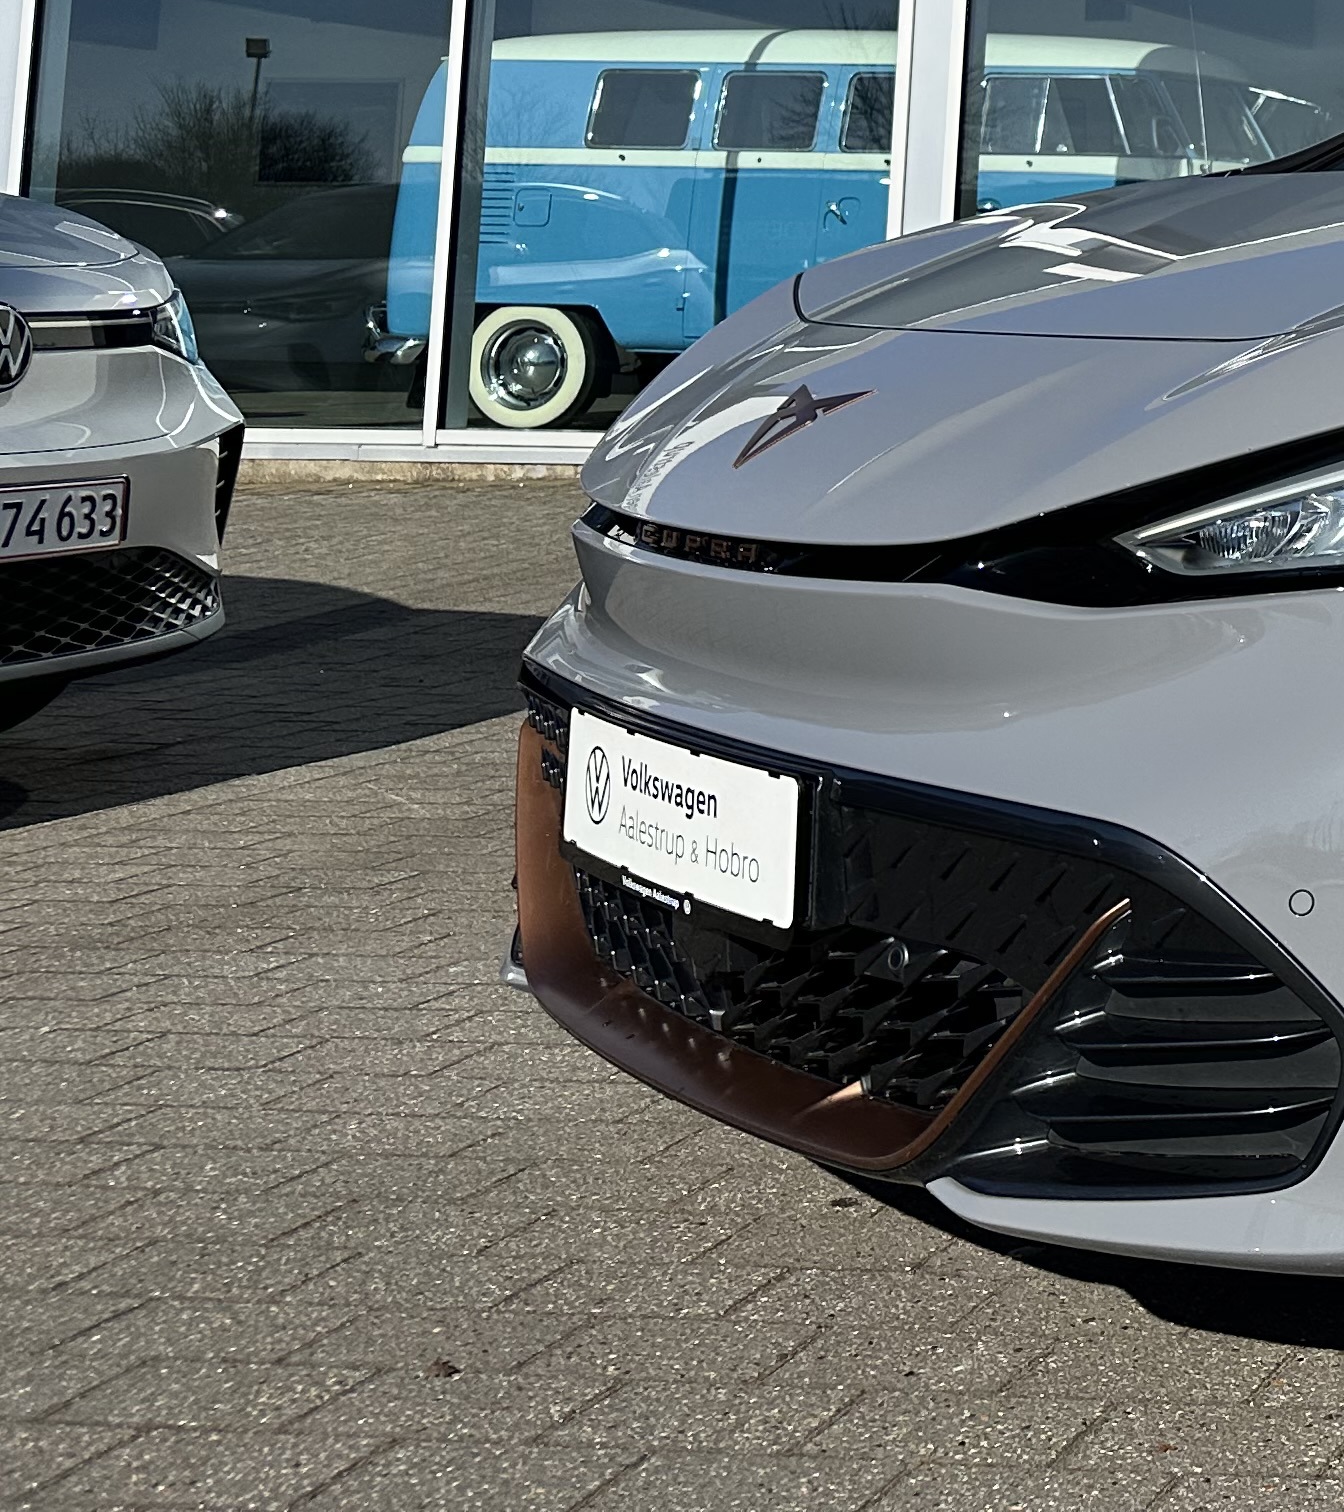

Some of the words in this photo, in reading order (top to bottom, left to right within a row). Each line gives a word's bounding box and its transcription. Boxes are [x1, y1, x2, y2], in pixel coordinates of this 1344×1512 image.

[1, 496, 48, 548] 74
[56, 492, 118, 542] 633
[641, 524, 760, 563] CUPRA
[621, 755, 718, 820] Volkswagen
[618, 804, 685, 865] Aalestrup
[690, 839, 700, 864] &
[705, 835, 760, 883] Hobro
